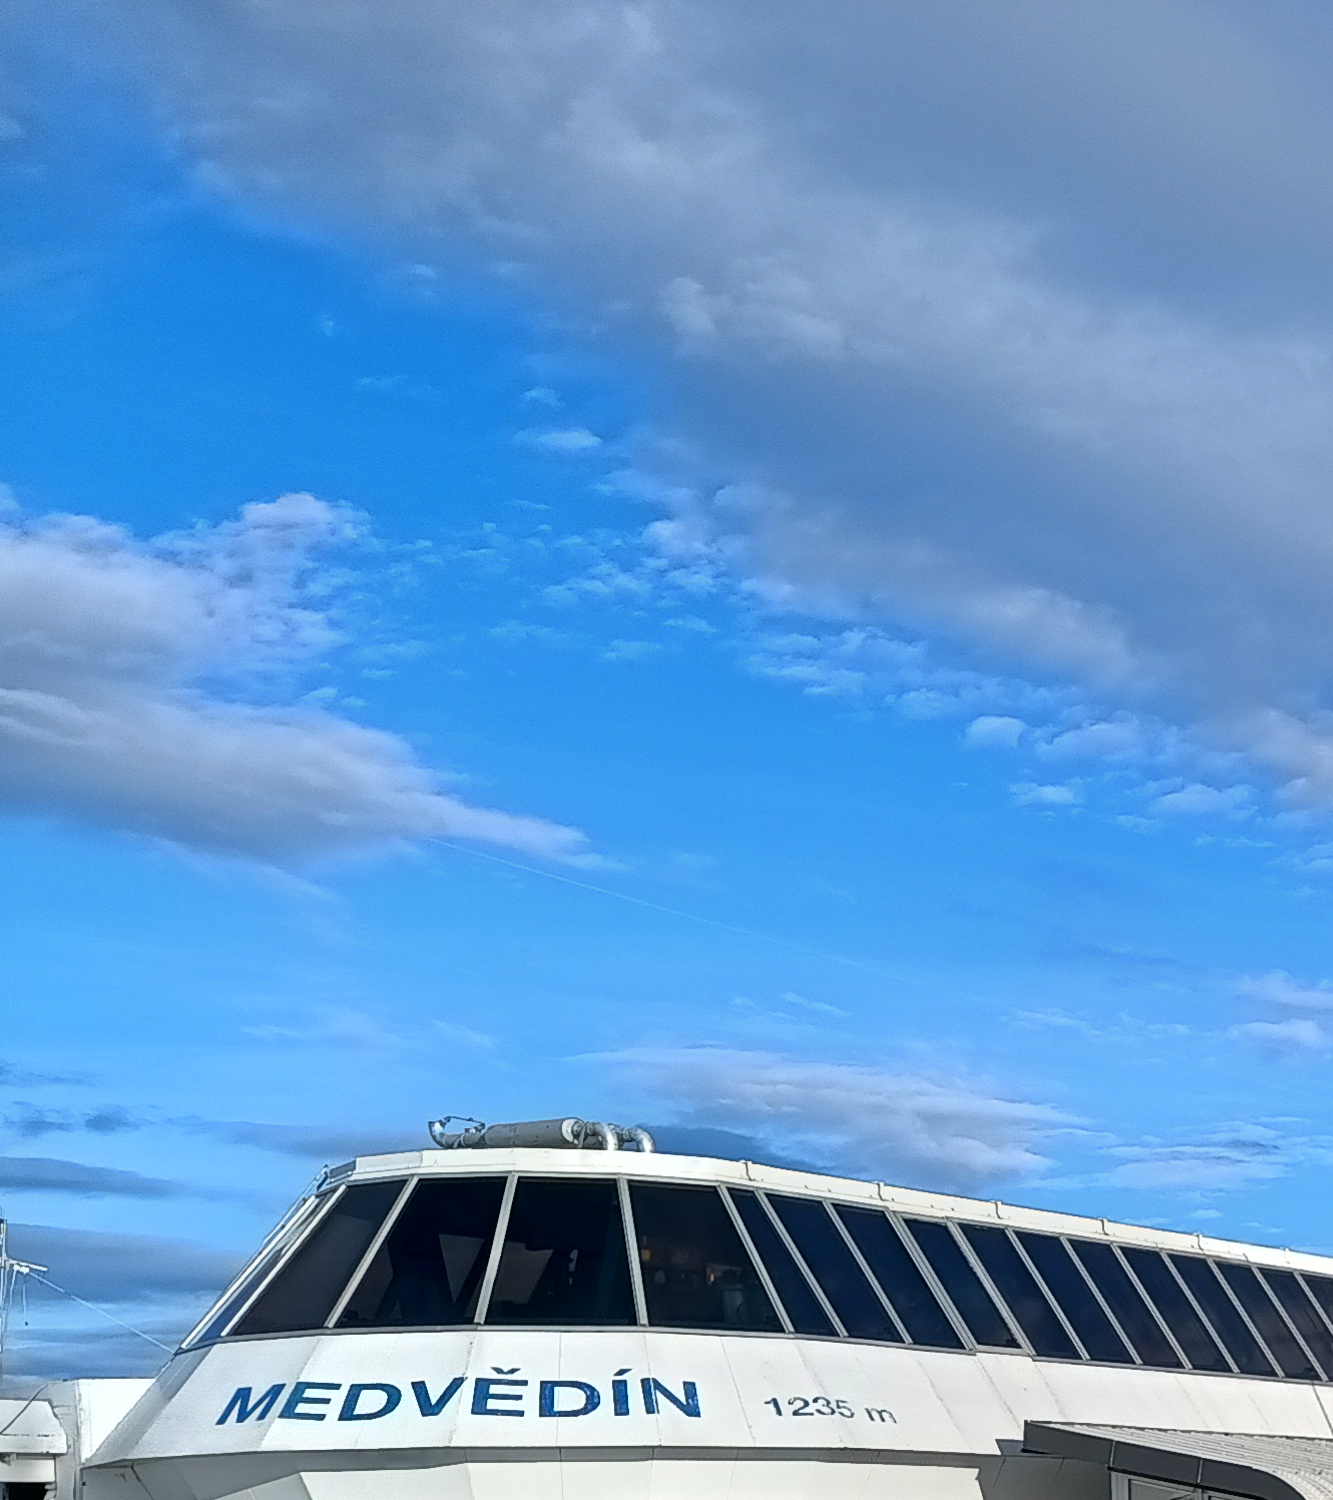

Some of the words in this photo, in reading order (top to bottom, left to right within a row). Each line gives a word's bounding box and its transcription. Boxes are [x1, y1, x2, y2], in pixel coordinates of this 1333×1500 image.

[215, 1366, 702, 1426] MEDVĚDÍN
[764, 1396, 855, 1418] 1235
[864, 1407, 898, 1424] m
